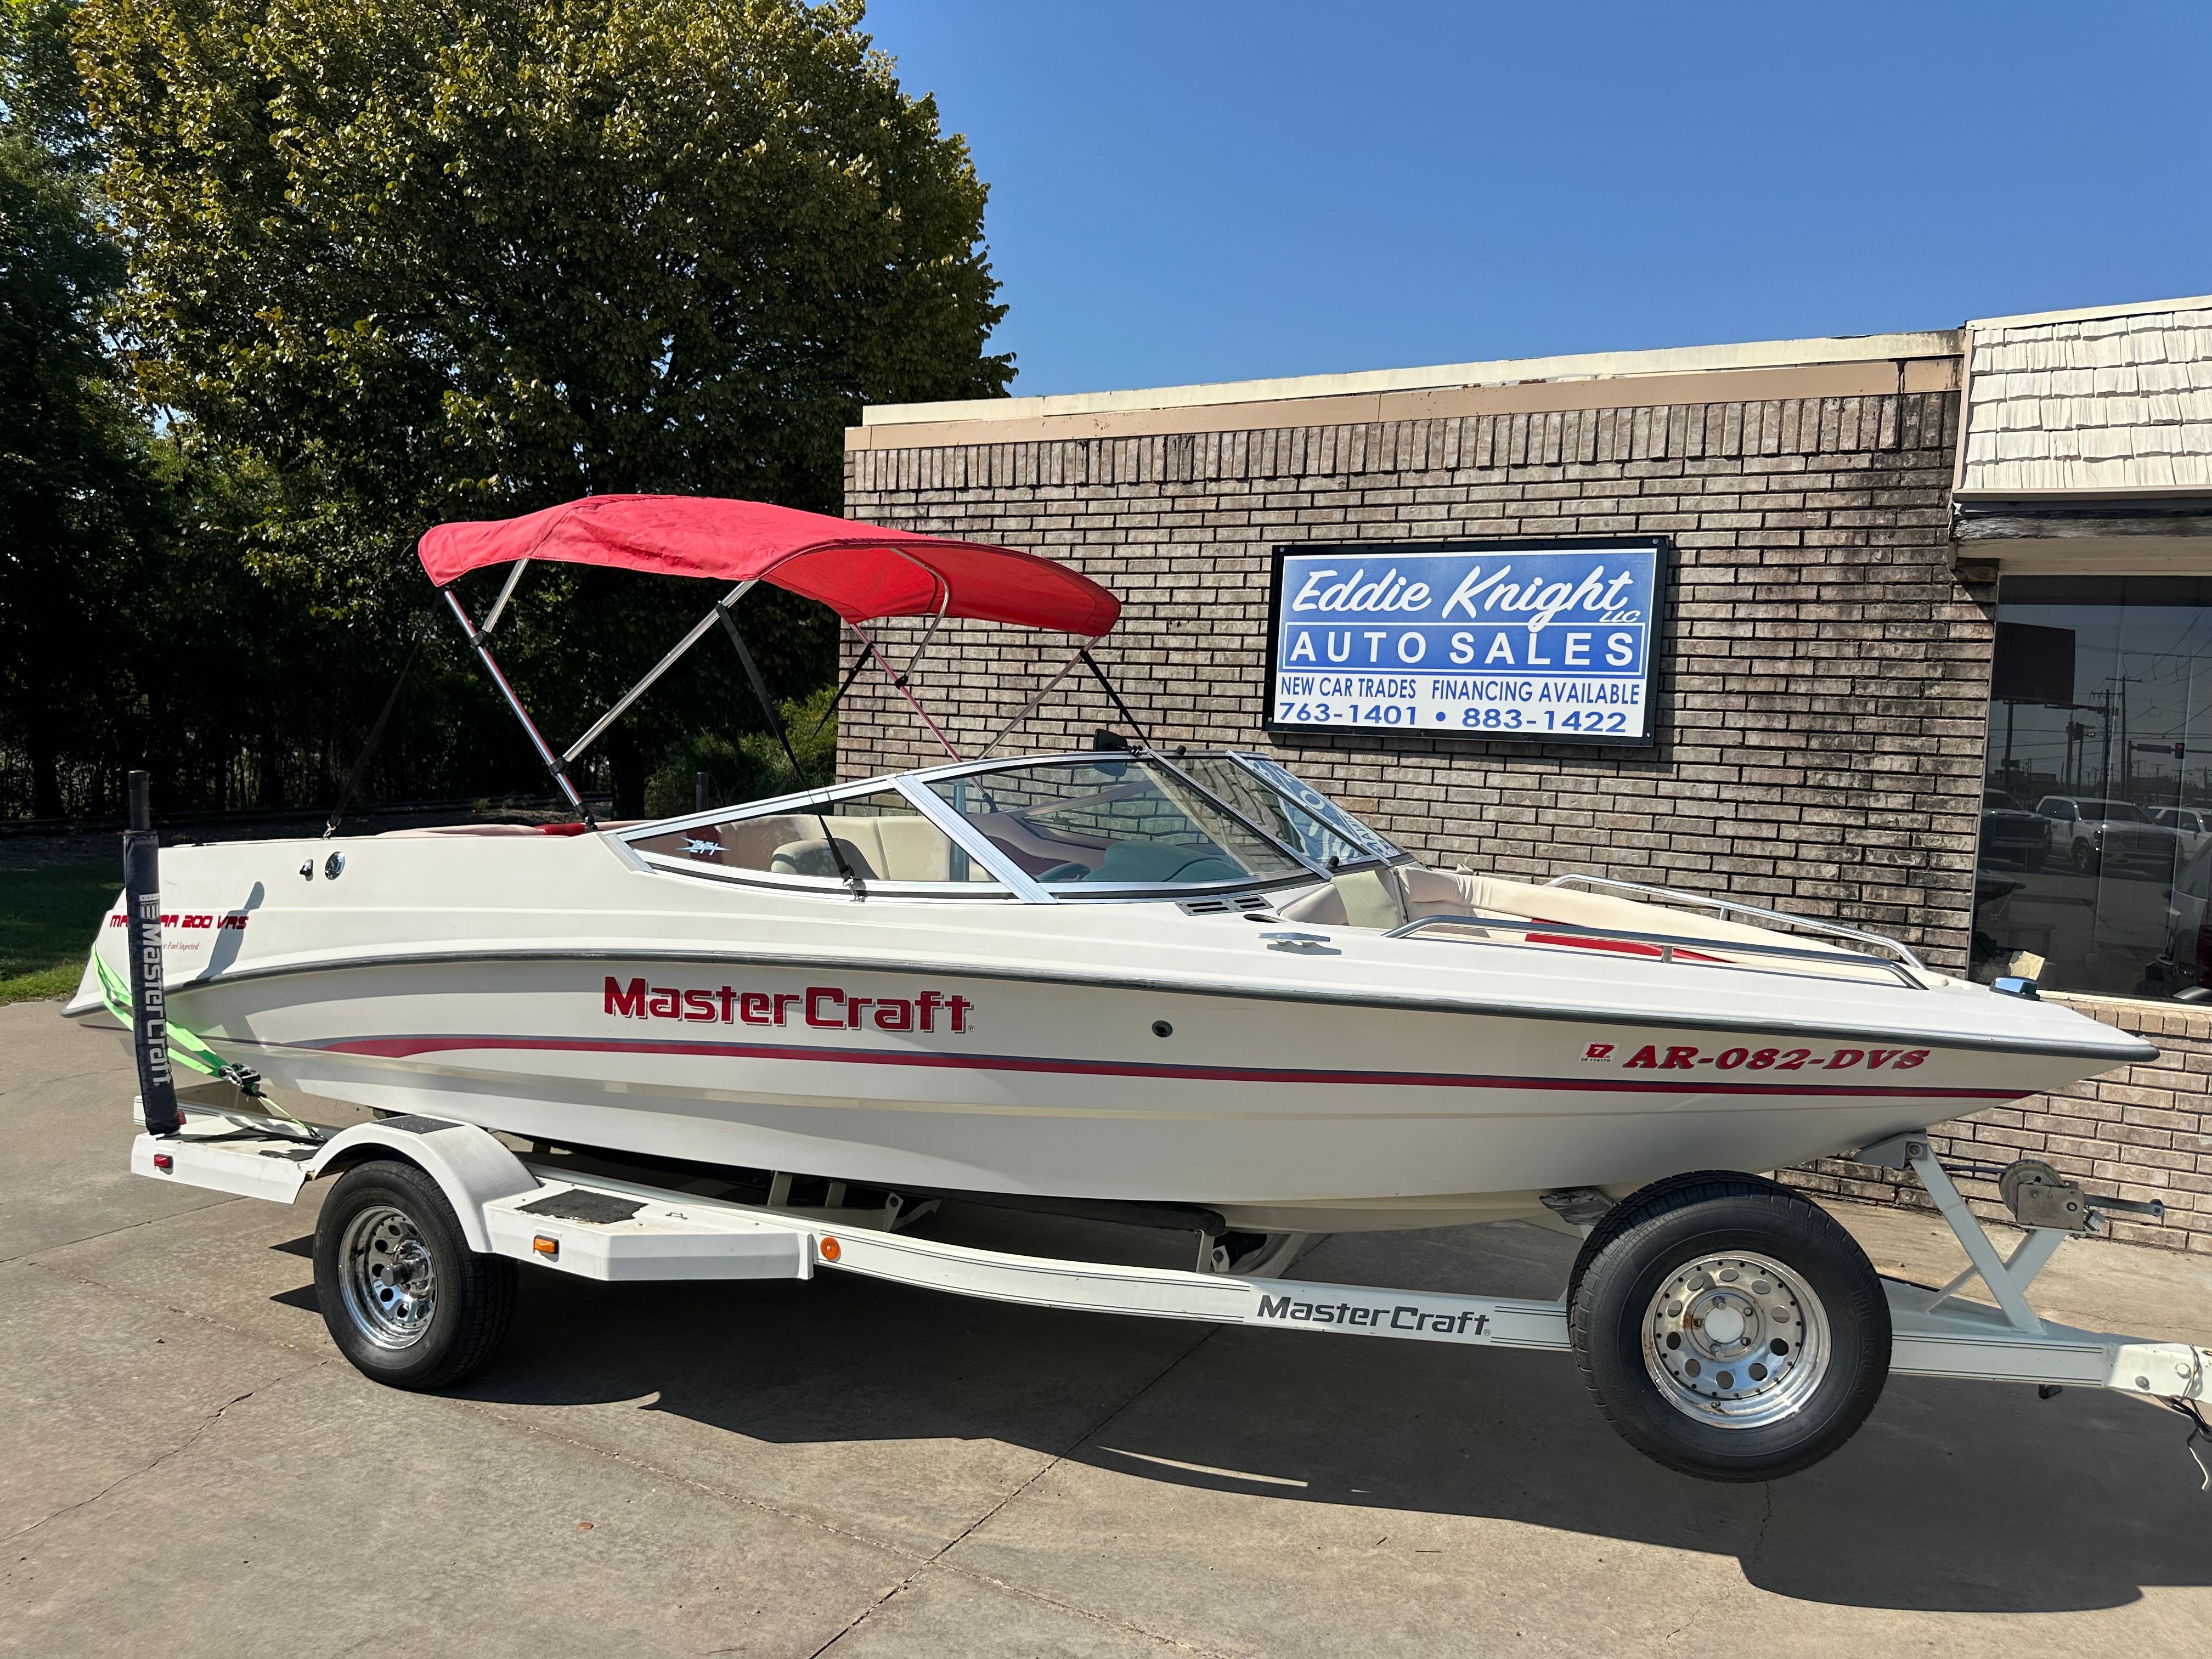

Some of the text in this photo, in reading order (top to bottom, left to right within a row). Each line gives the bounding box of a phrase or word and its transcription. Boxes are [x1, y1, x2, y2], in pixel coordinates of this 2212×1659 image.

[1293, 565, 1634, 633] Eddie Knight
[1599, 610, 1641, 624] LLC
[1289, 631, 1634, 666] AUTO SALES
[1281, 677, 1640, 706] NEW CAR TRADES FINANCING AVAILABLE
[1279, 702, 1627, 733] 763-1401 883-1422
[182, 915, 213, 929] 200
[143, 923, 172, 1086] MasterCraft
[604, 976, 973, 1034] MasterCraft
[1593, 1046, 1605, 1054] 7
[1622, 1045, 1931, 1070] AR-082-DVS
[1257, 1295, 1490, 1335] MasterCraft
